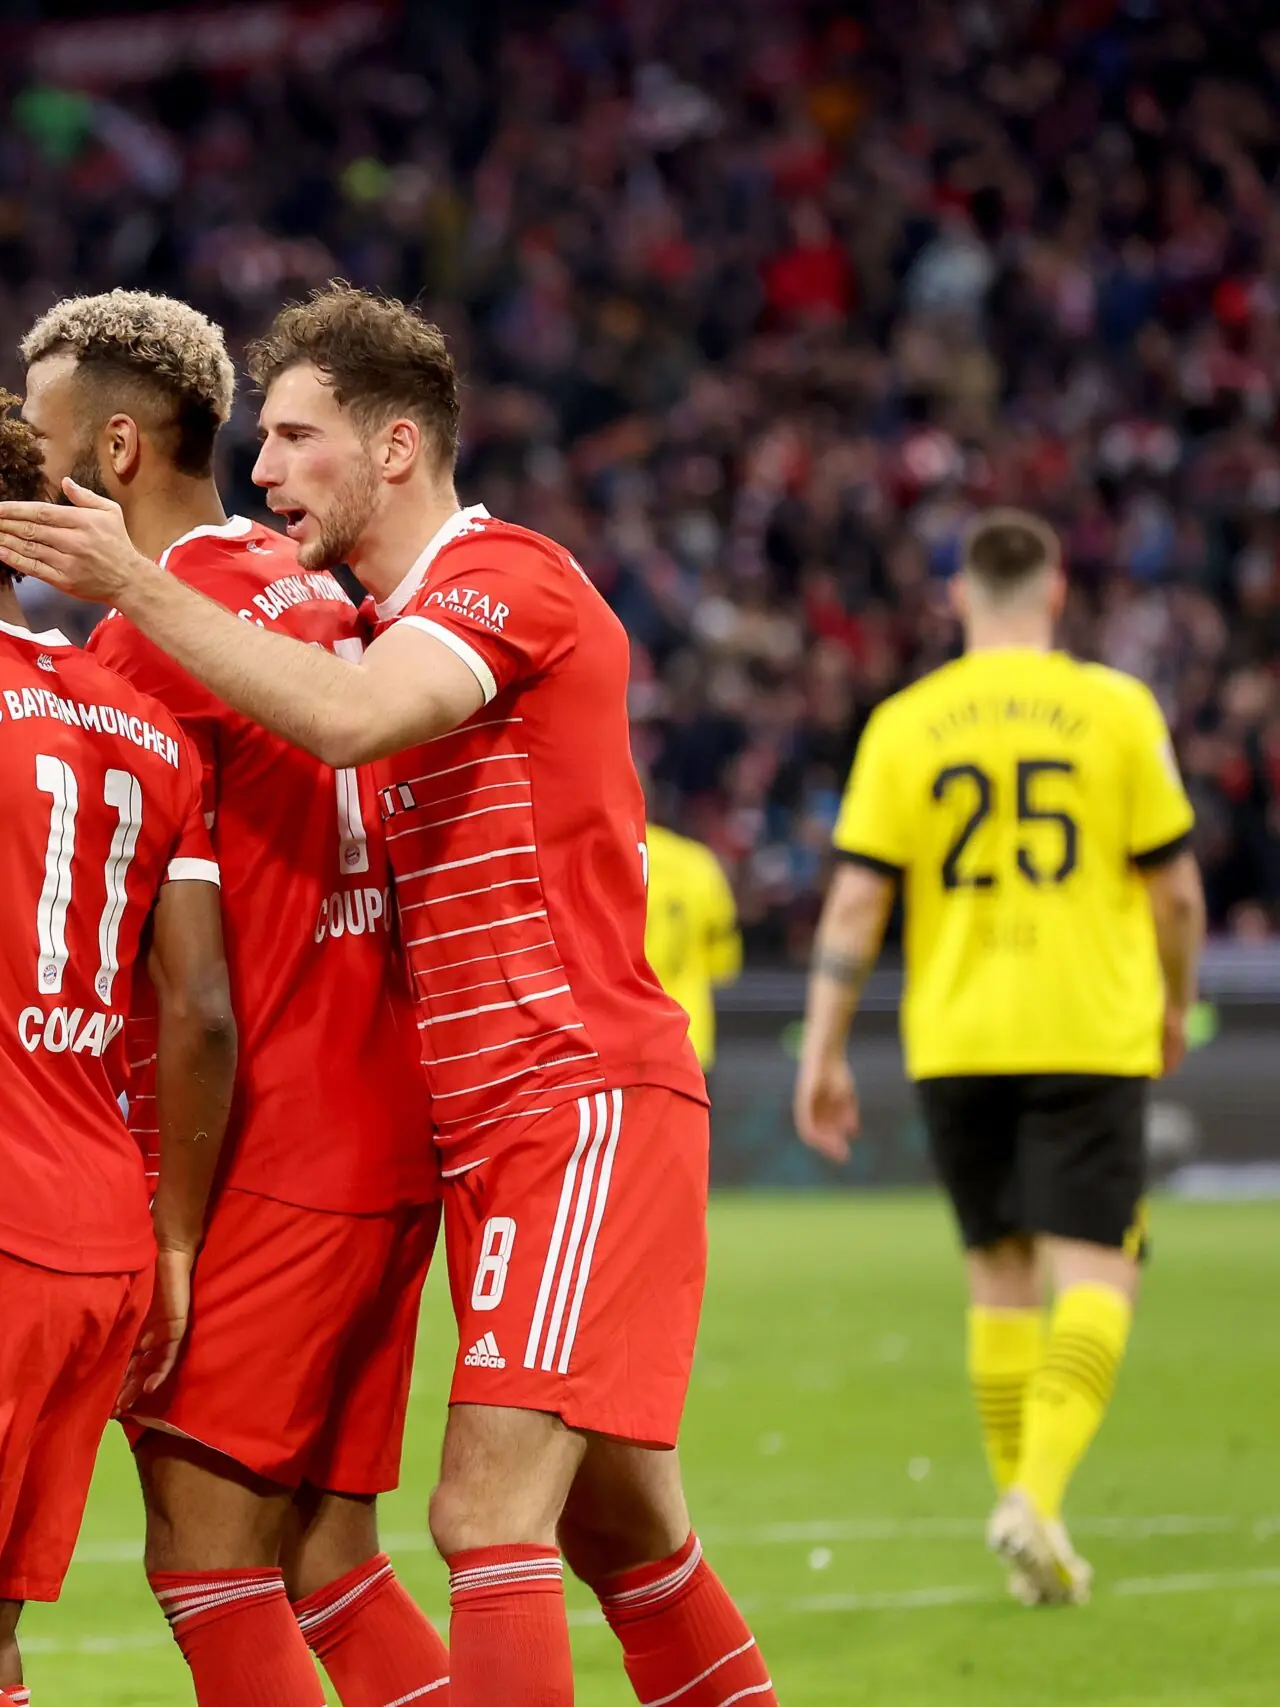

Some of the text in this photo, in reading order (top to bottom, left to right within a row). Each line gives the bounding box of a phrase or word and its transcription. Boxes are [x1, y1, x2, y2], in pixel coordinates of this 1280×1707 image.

[78, 702, 179, 770] MÜNCHEN
[931, 760, 1078, 889] 25
[35, 753, 143, 1007] 11
[471, 1216, 517, 1311] 8
[464, 1352, 507, 1370] adidas
